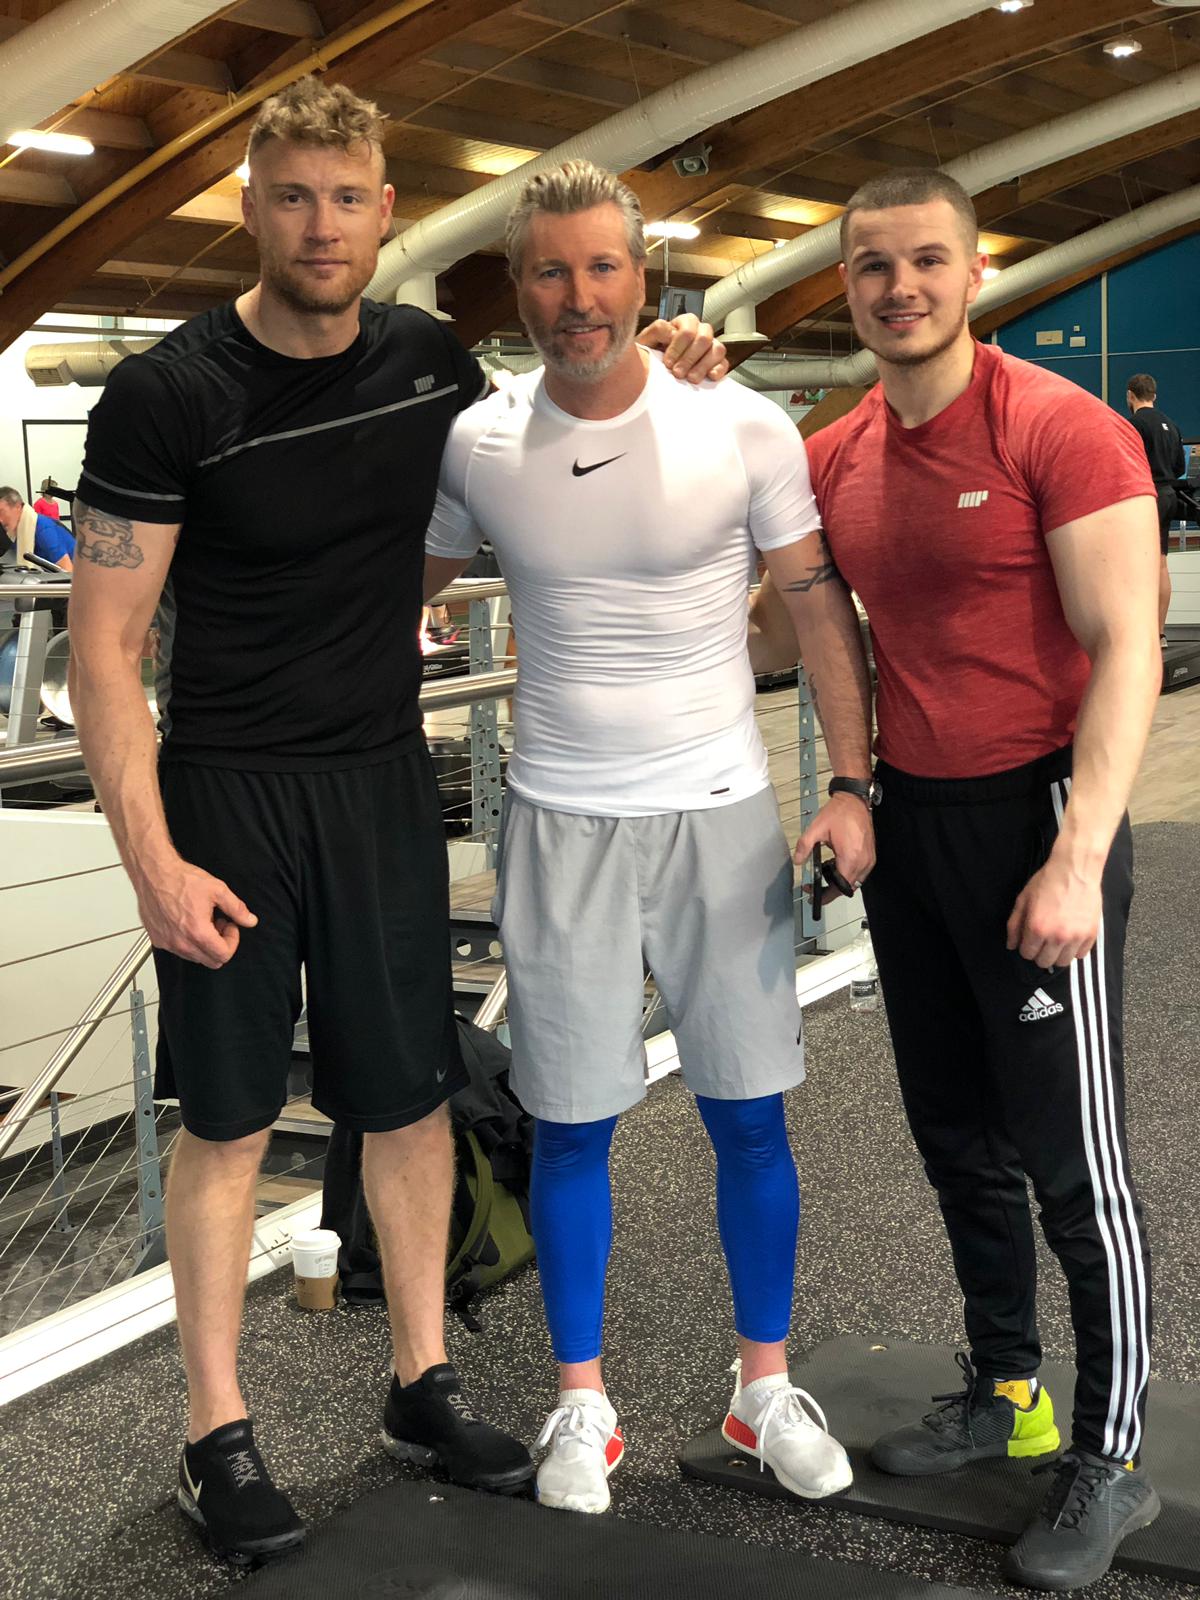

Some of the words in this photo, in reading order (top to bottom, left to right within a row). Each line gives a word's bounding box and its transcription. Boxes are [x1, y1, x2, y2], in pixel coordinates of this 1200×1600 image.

[1019, 1003, 1064, 1022] adidas
[446, 1394, 481, 1421] AIR
[227, 1450, 260, 1488] MAX
